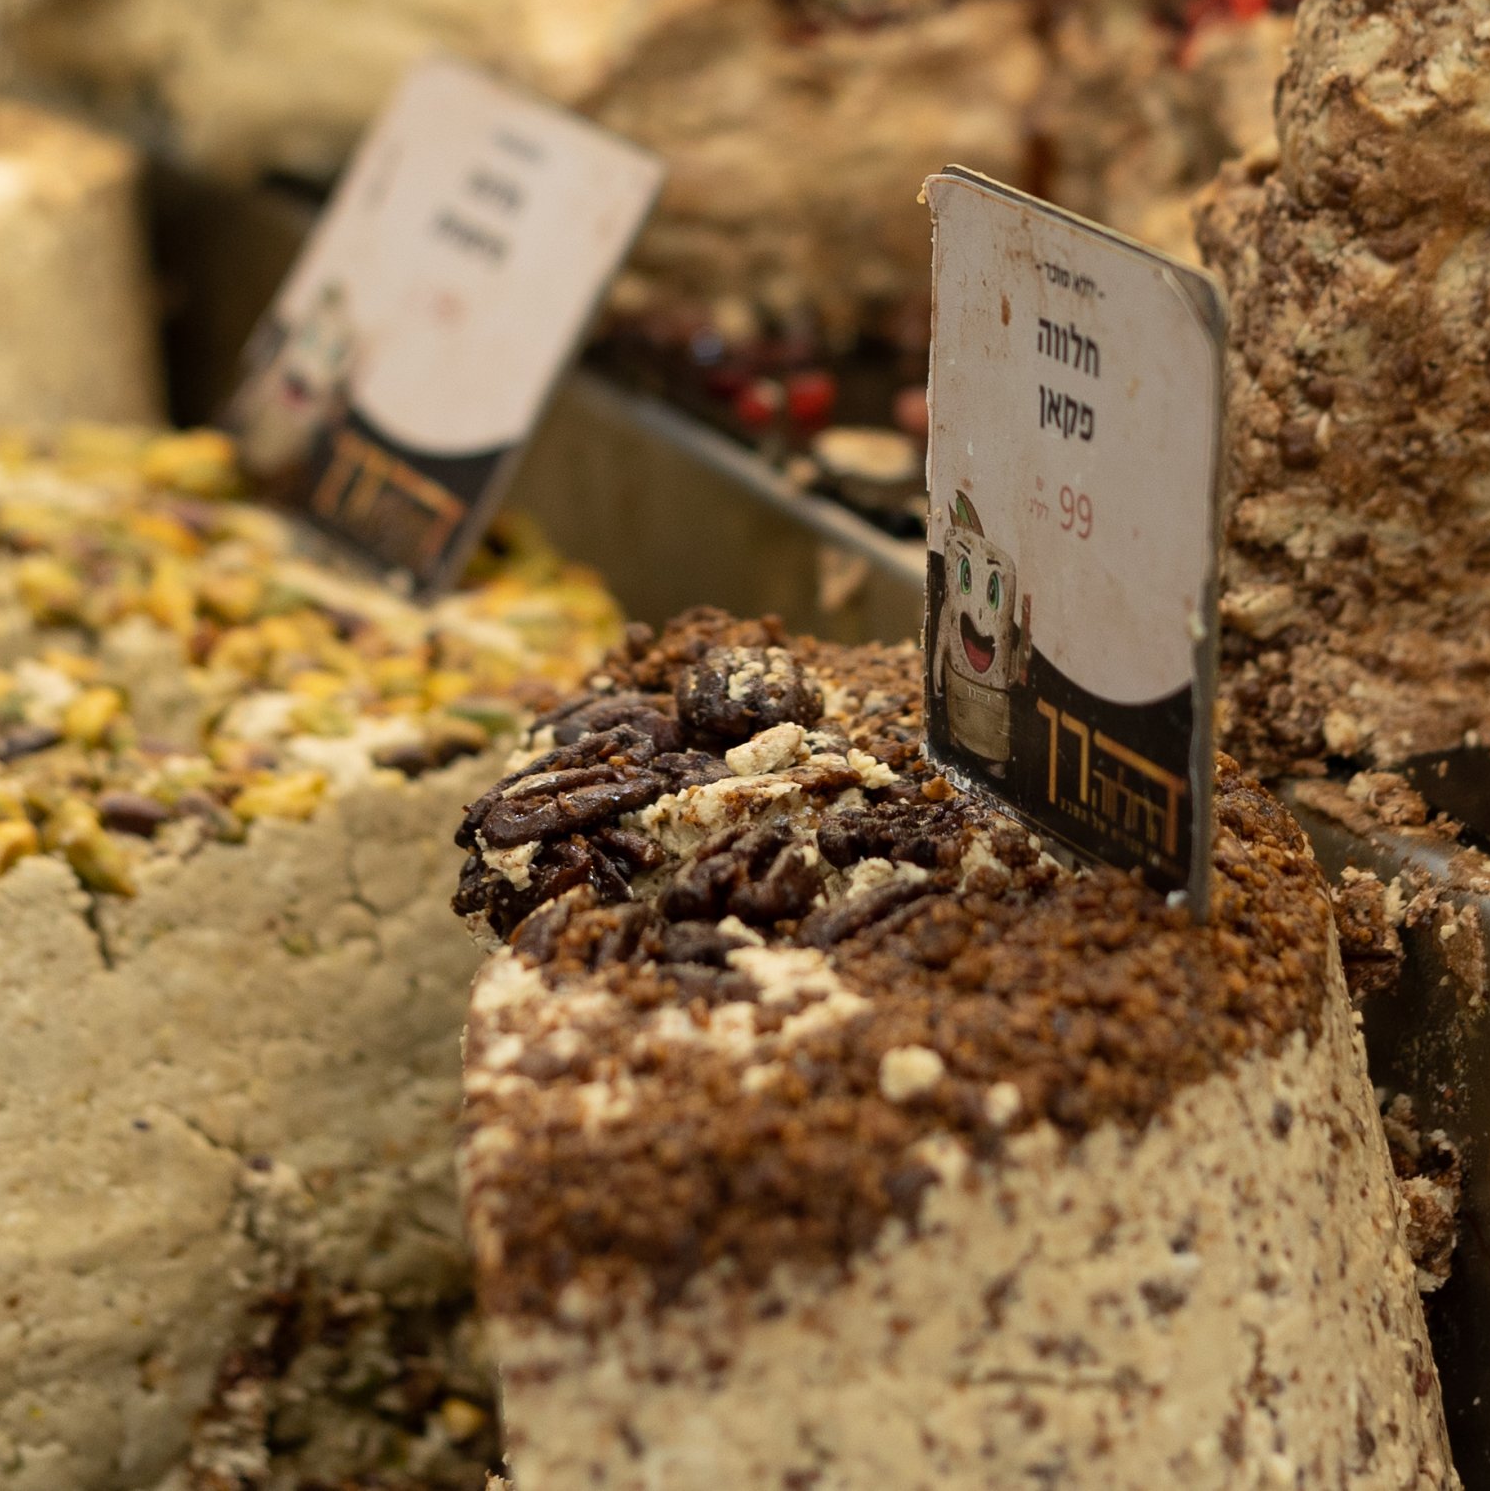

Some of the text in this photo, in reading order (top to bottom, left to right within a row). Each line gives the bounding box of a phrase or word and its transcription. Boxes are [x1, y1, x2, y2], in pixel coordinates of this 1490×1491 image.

[1037, 316, 1100, 380] חלווה
[1038, 383, 1094, 443] פקאן
[1059, 483, 1094, 542] 99
